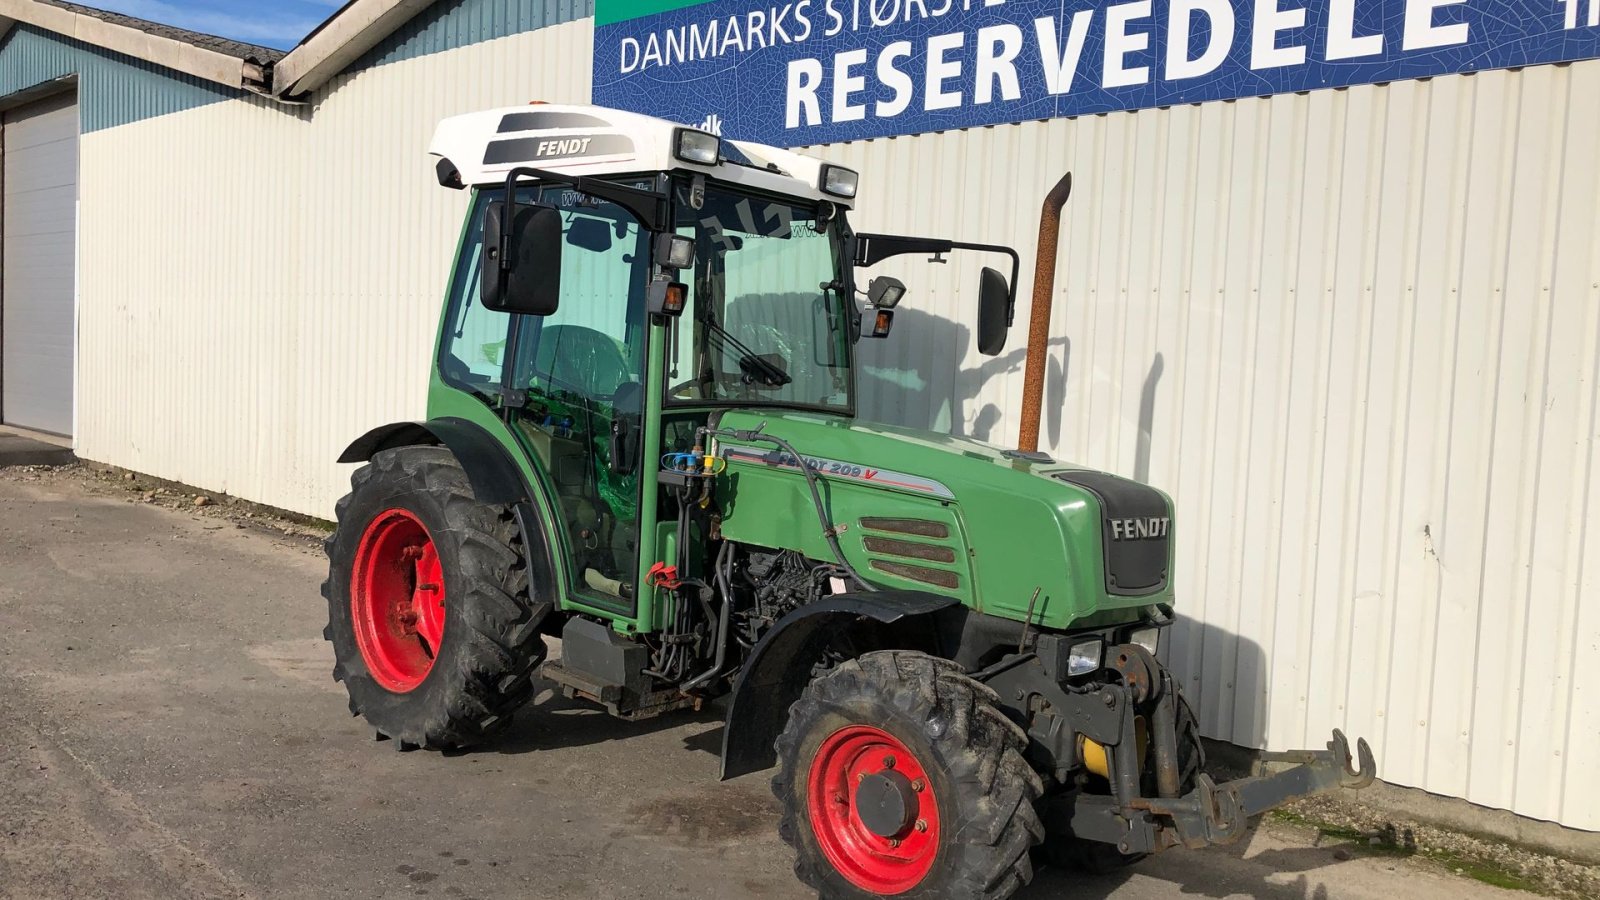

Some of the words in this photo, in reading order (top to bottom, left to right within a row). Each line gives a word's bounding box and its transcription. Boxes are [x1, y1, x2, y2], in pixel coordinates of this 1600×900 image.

[620, 0, 812, 74] DANMARKS
[824, 0, 1008, 36] STØR
[785, 0, 1469, 129] RESERVEDELE
[536, 138, 592, 156] FENDT
[829, 463, 861, 477] 209
[864, 469, 878, 479] V
[1111, 517, 1169, 539] FENDT
